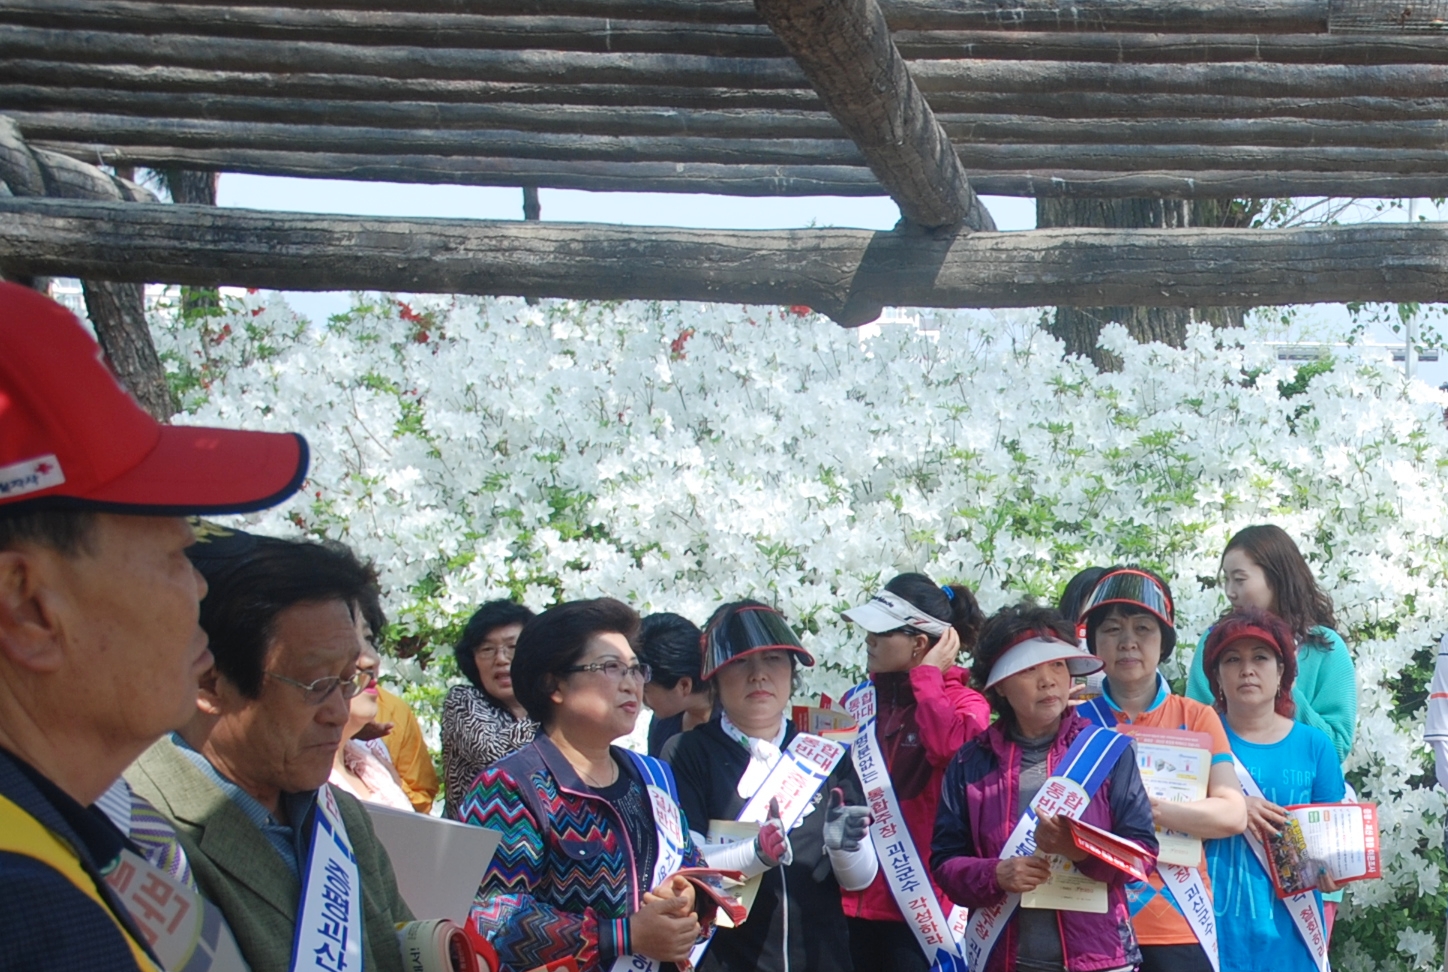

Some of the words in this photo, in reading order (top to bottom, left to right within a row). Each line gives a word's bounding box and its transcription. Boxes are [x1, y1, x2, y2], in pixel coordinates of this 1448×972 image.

[849, 690, 874, 714] 통합
[795, 743, 833, 773] 반대
[801, 736, 840, 760] 통합
[867, 786, 898, 839] 통합주장
[1044, 781, 1083, 811] 통합
[654, 807, 682, 844] 반대
[885, 840, 921, 893] 괴산군수
[908, 896, 944, 945] 각성하라
